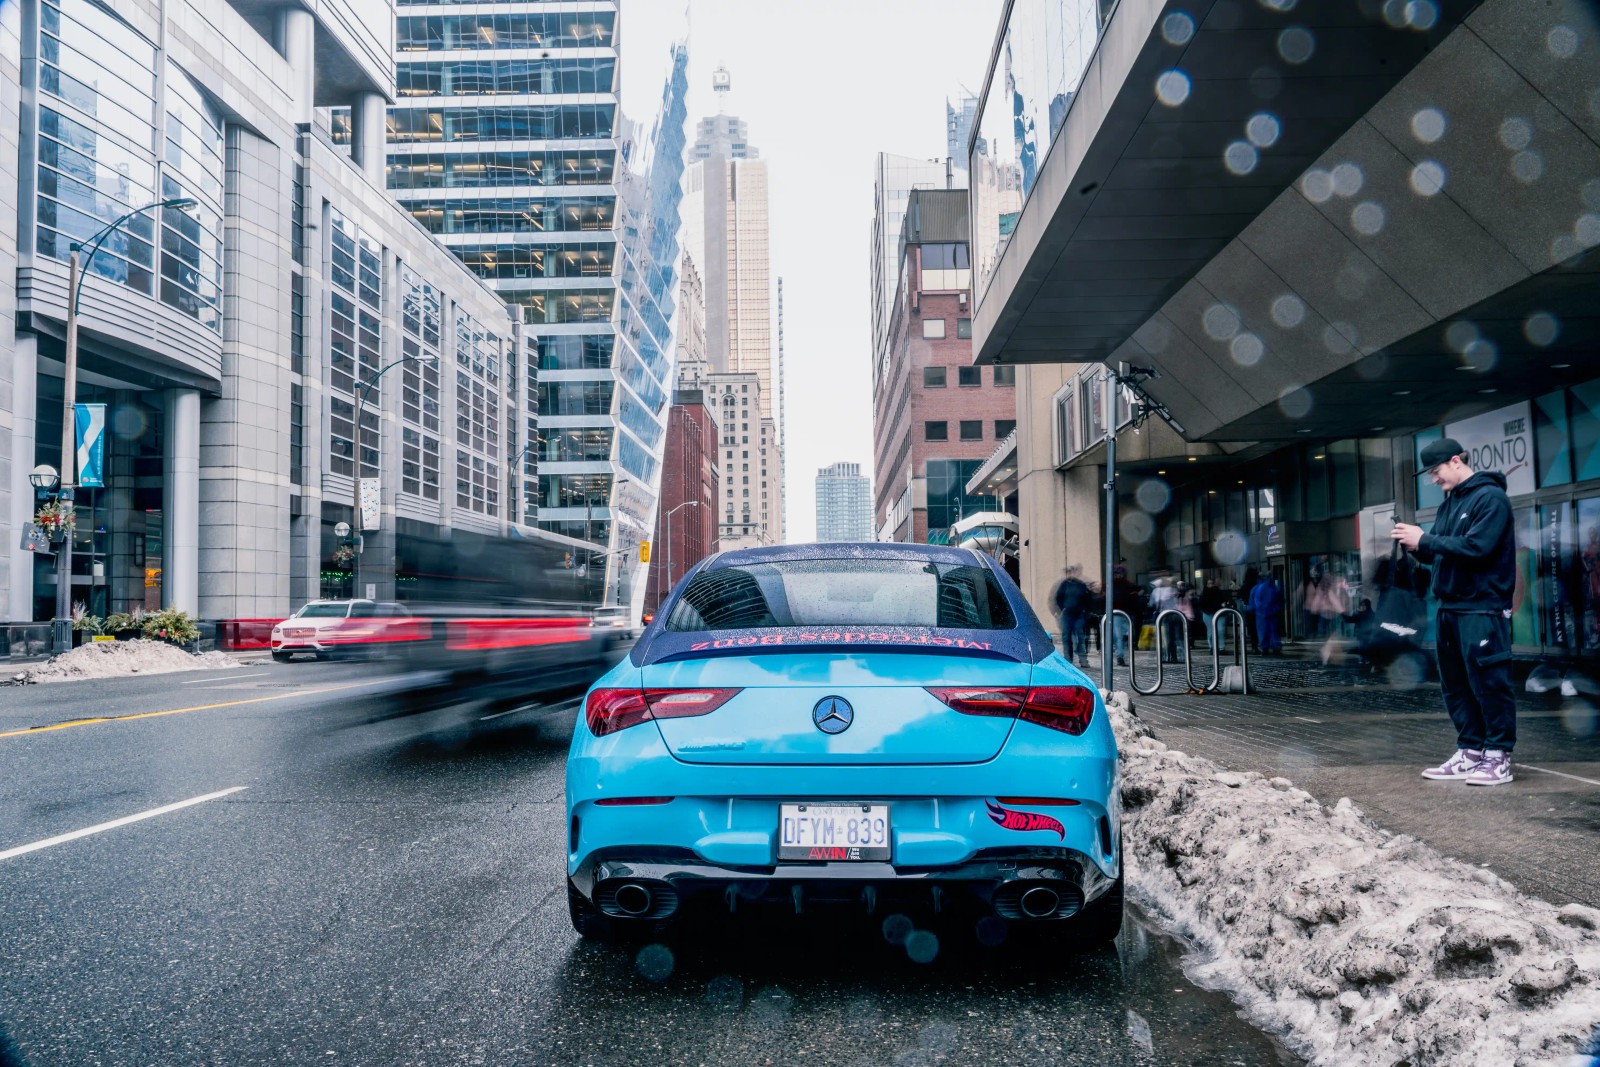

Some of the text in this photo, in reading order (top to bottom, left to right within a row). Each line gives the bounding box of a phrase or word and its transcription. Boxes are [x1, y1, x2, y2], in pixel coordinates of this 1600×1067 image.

[1503, 417, 1526, 437] WHERE
[1467, 436, 1527, 472] RONTO
[1551, 544, 1557, 558] OF
[1551, 561, 1559, 603] CENTRE
[1554, 606, 1562, 627] THE
[690, 632, 991, 651] Mercedes-Benz
[813, 808, 856, 816] ONTARIO
[847, 818, 885, 844] 839
